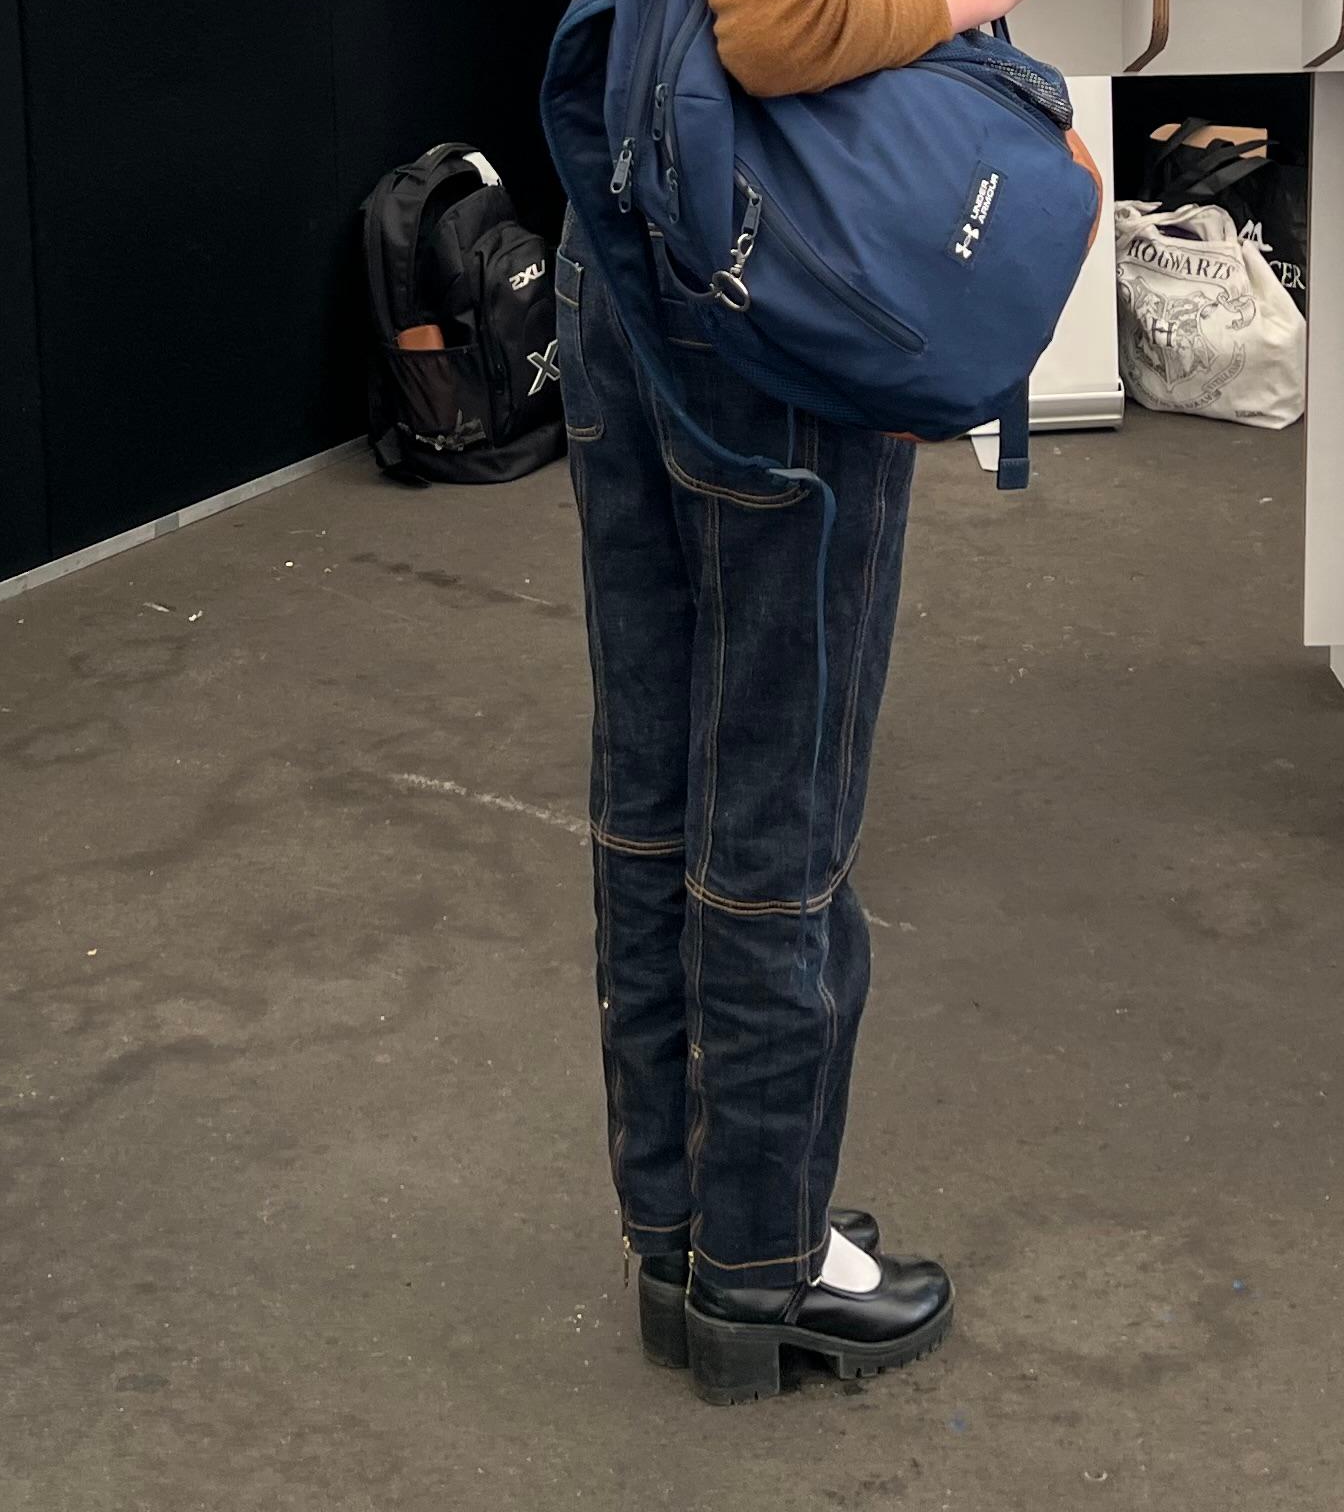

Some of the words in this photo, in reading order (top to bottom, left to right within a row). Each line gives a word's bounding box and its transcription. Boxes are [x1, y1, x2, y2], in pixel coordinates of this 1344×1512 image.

[970, 179, 989, 220] UNDER
[978, 173, 1000, 224] ARMOUR
[1127, 239, 1235, 281] HOGWARTS
